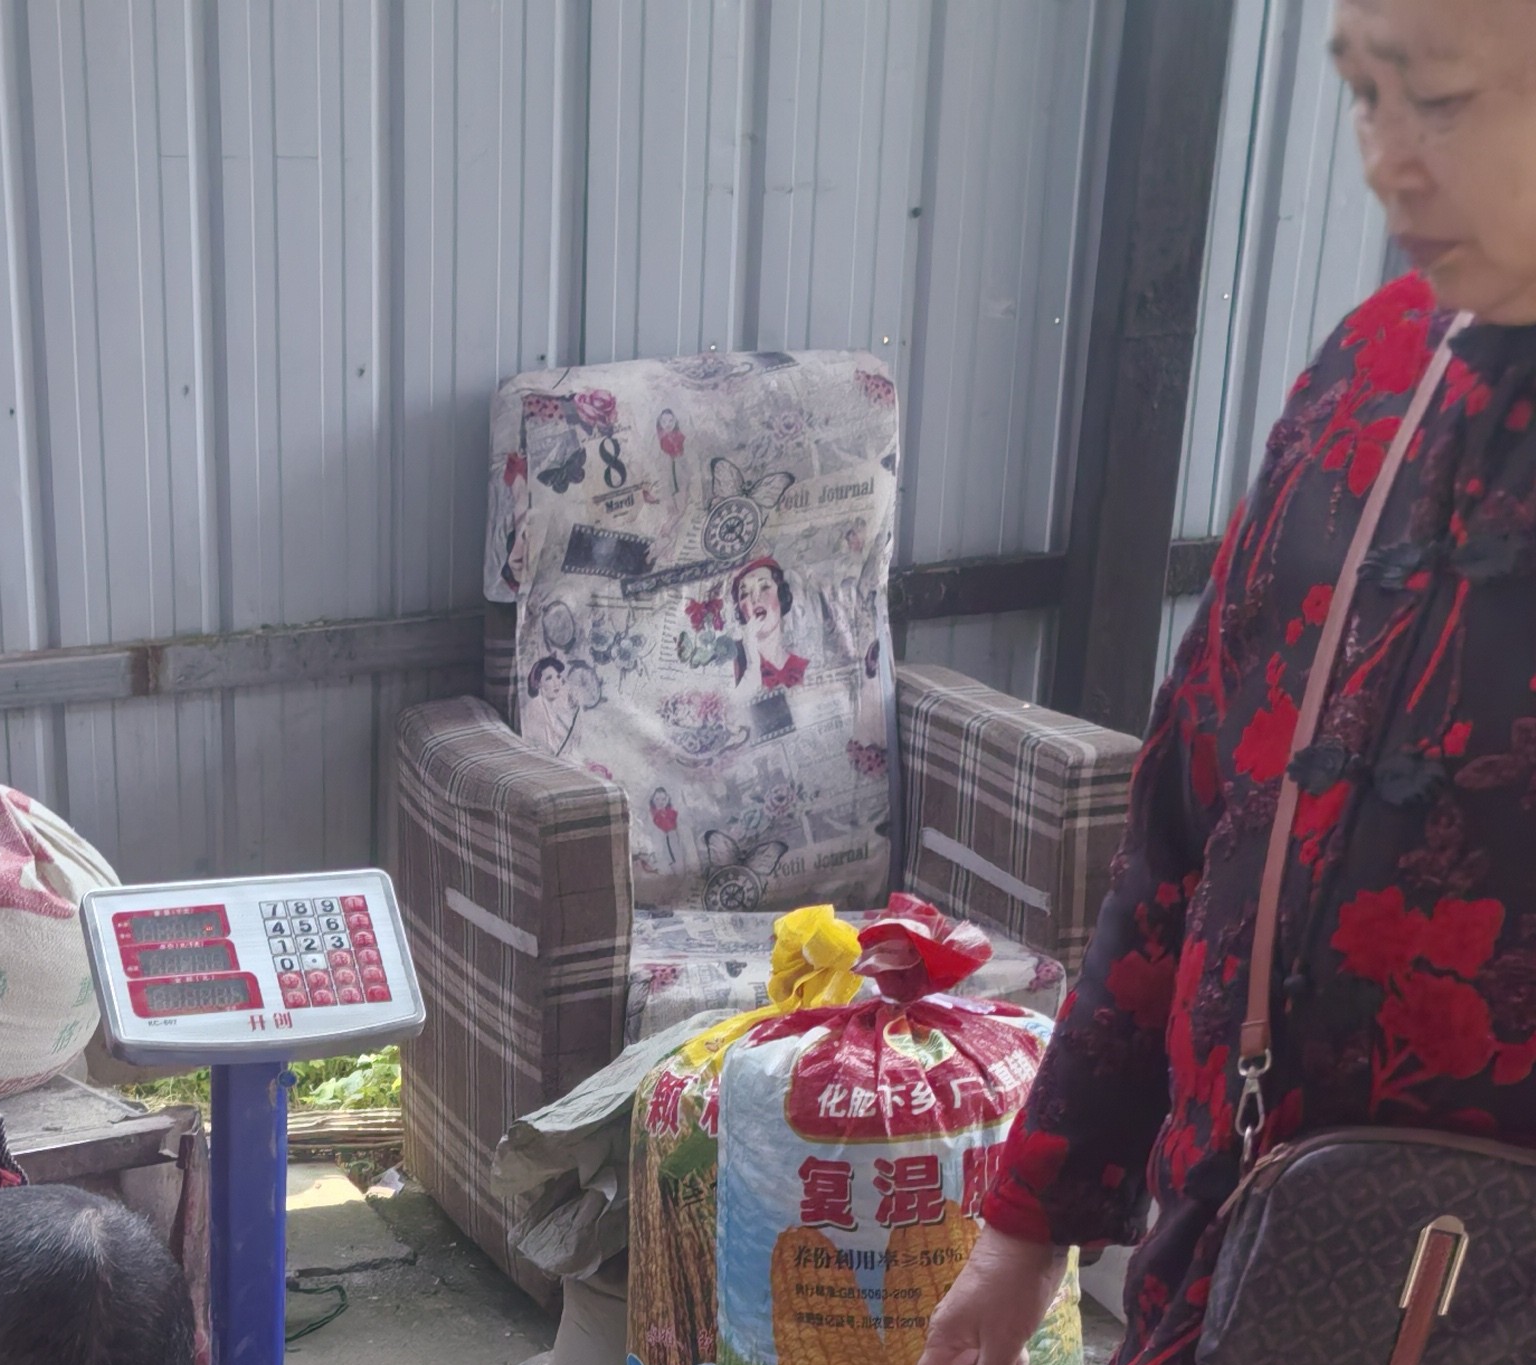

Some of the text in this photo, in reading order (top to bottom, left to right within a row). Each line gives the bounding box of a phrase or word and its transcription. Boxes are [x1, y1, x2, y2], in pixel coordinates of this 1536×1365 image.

[598, 436, 627, 489] 8
[266, 899, 335, 918] 7 8 9
[272, 917, 339, 935] 4 5 6
[277, 935, 344, 954] 1 2 3
[280, 957, 294, 971] 0
[248, 1010, 294, 1032] 开创
